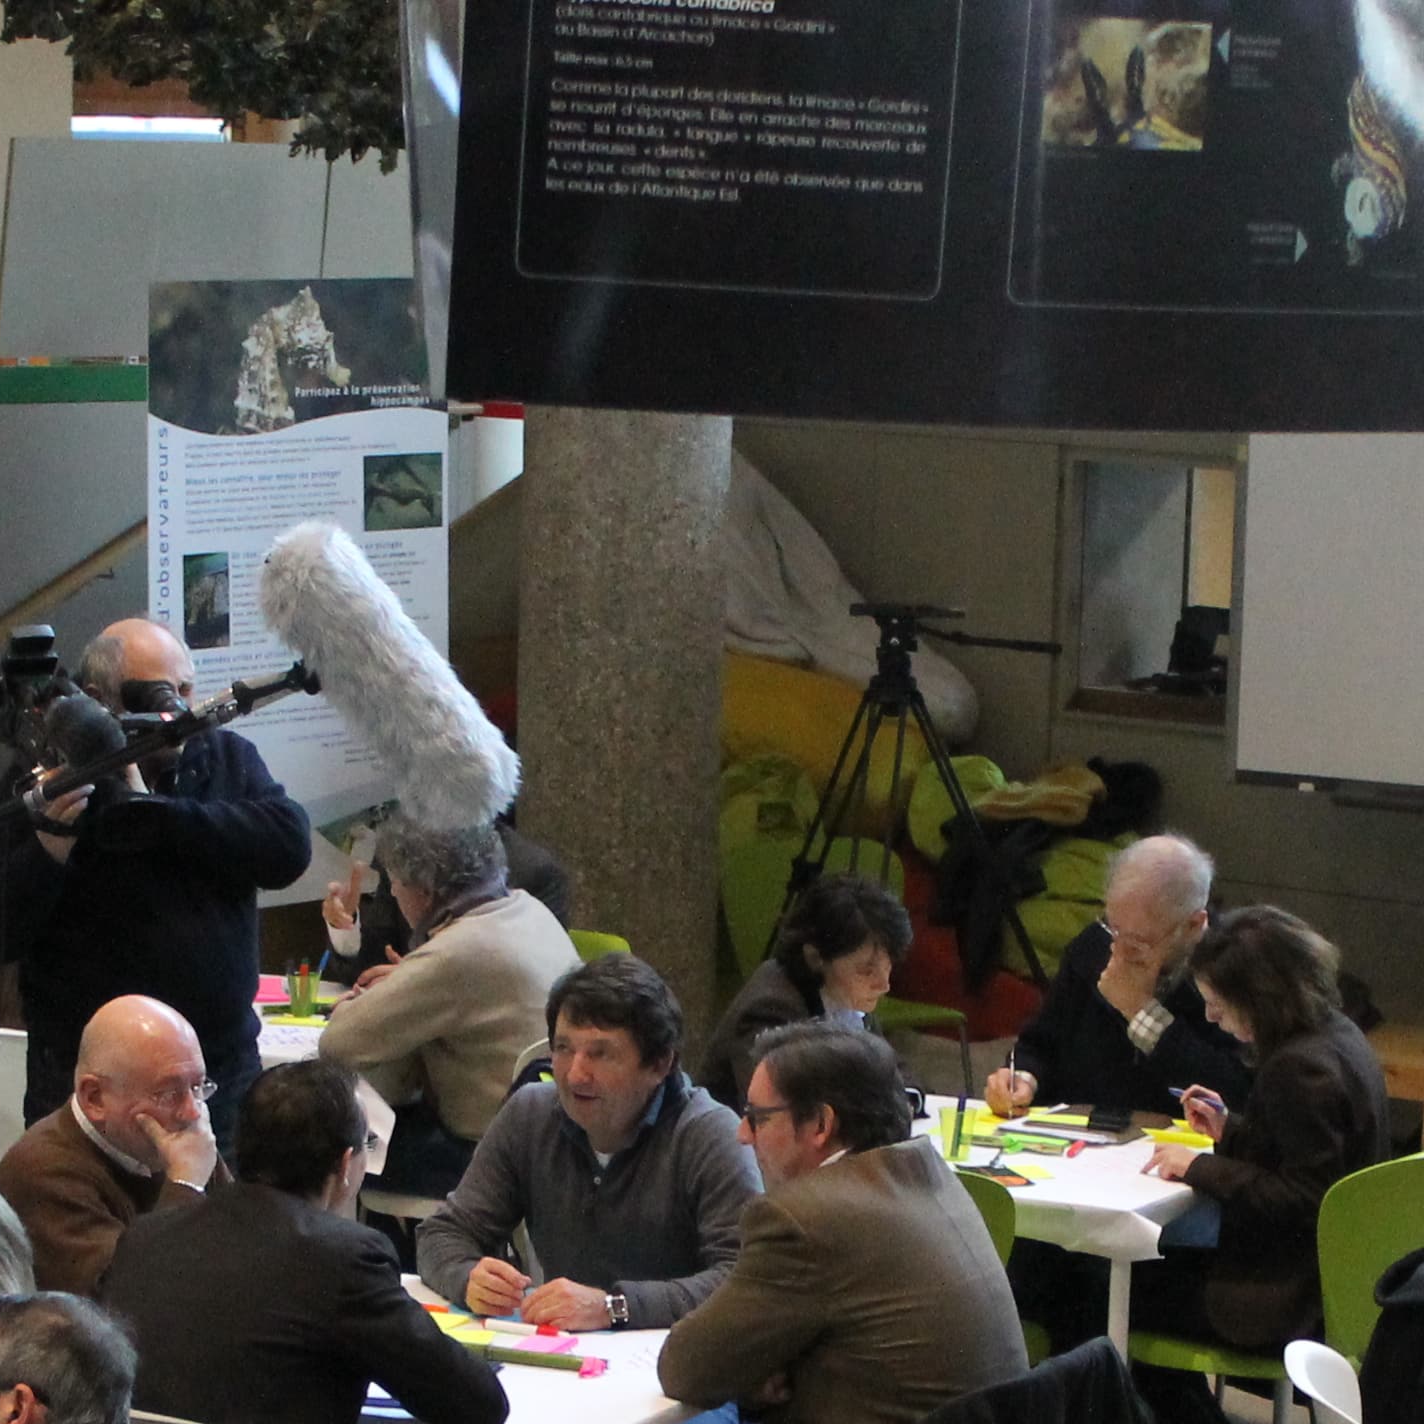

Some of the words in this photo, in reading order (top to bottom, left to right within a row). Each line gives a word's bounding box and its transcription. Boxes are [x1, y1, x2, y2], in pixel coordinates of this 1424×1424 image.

[551, 79, 612, 95] Comme
[631, 84, 684, 101] plupart
[687, 87, 714, 101] des
[887, 178, 924, 193] dans
[294, 386, 341, 399] Participez
[343, 384, 349, 396] à
[351, 384, 361, 396] la
[361, 384, 421, 396] préservation
